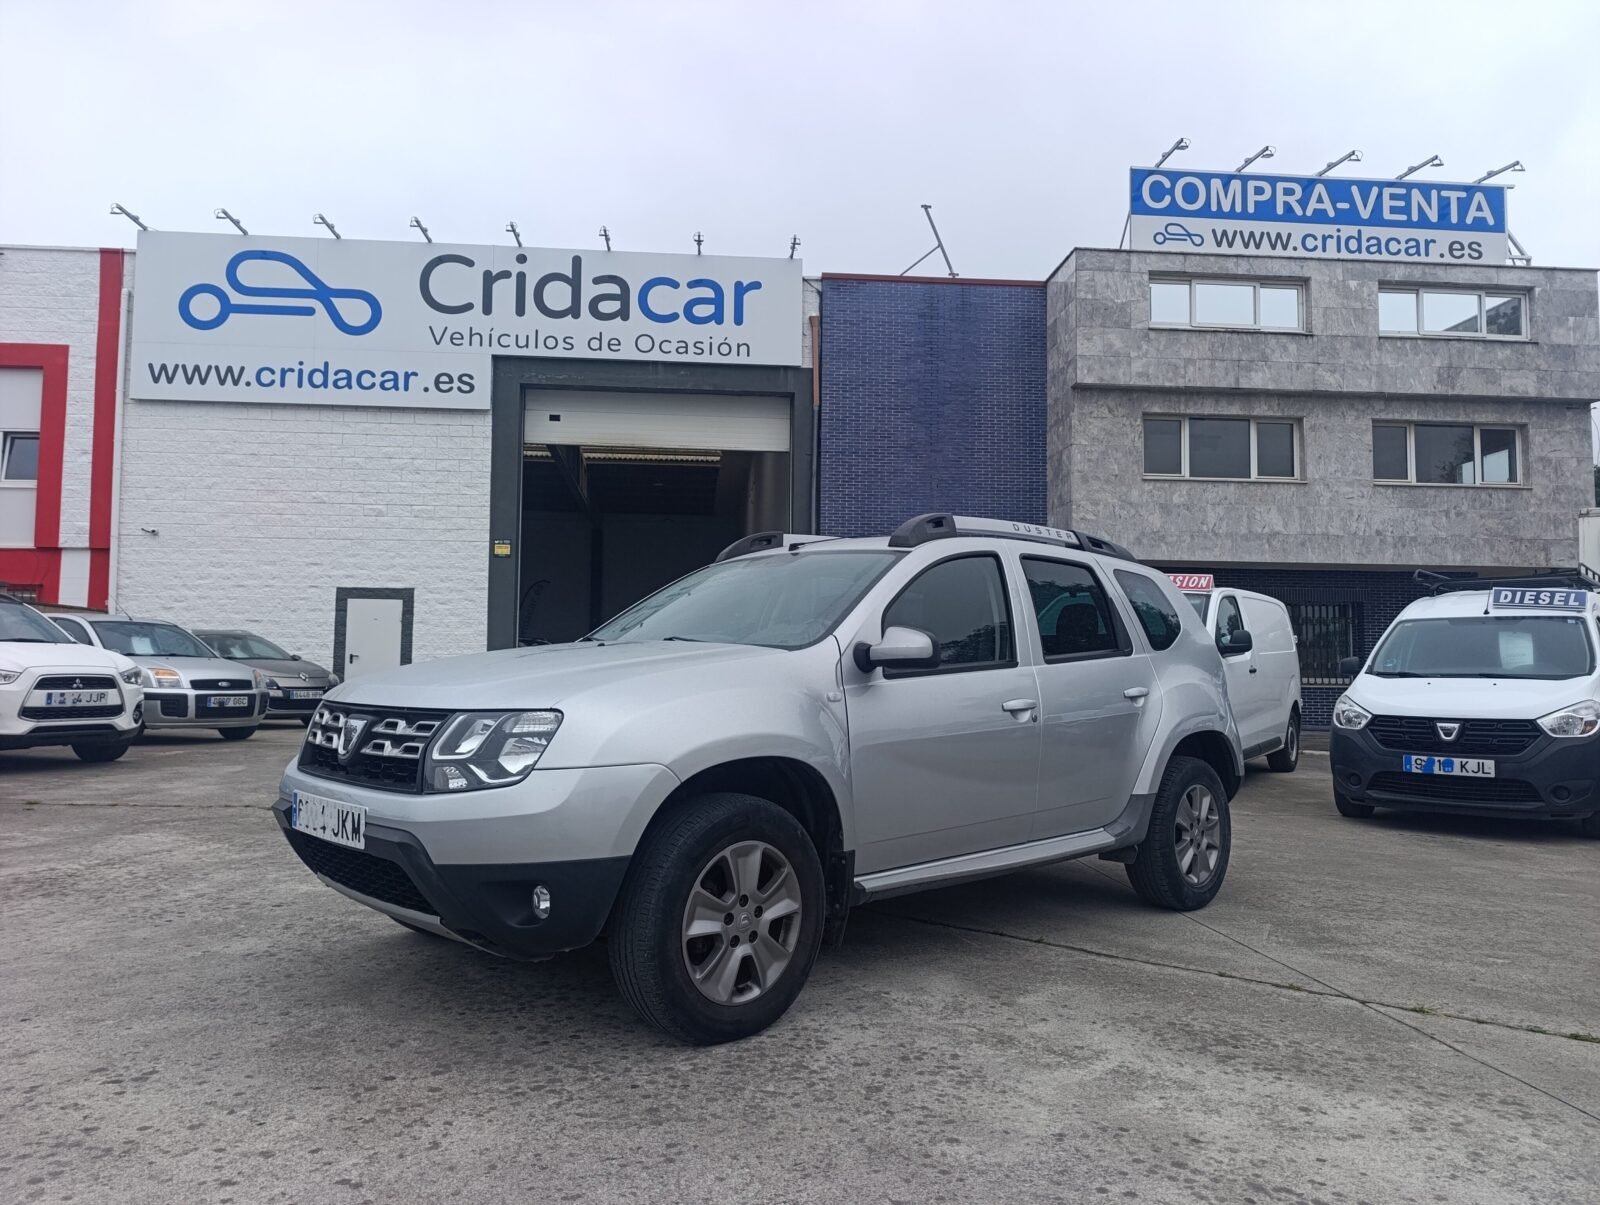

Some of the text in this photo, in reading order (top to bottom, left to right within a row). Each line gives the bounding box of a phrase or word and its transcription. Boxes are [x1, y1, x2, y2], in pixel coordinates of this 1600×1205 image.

[1142, 174, 1495, 226] COMPRA-VENTA
[1211, 227, 1484, 261] www.cridacar.es
[419, 253, 763, 326] Cridacar
[428, 325, 751, 358] Vehículos de Ocasión
[147, 360, 476, 395] www.cridacar.es
[1012, 523, 1073, 540] DUSTER
[1499, 590, 1580, 606] DIESEL
[1460, 760, 1492, 775] KJL
[331, 808, 361, 843] JKM
